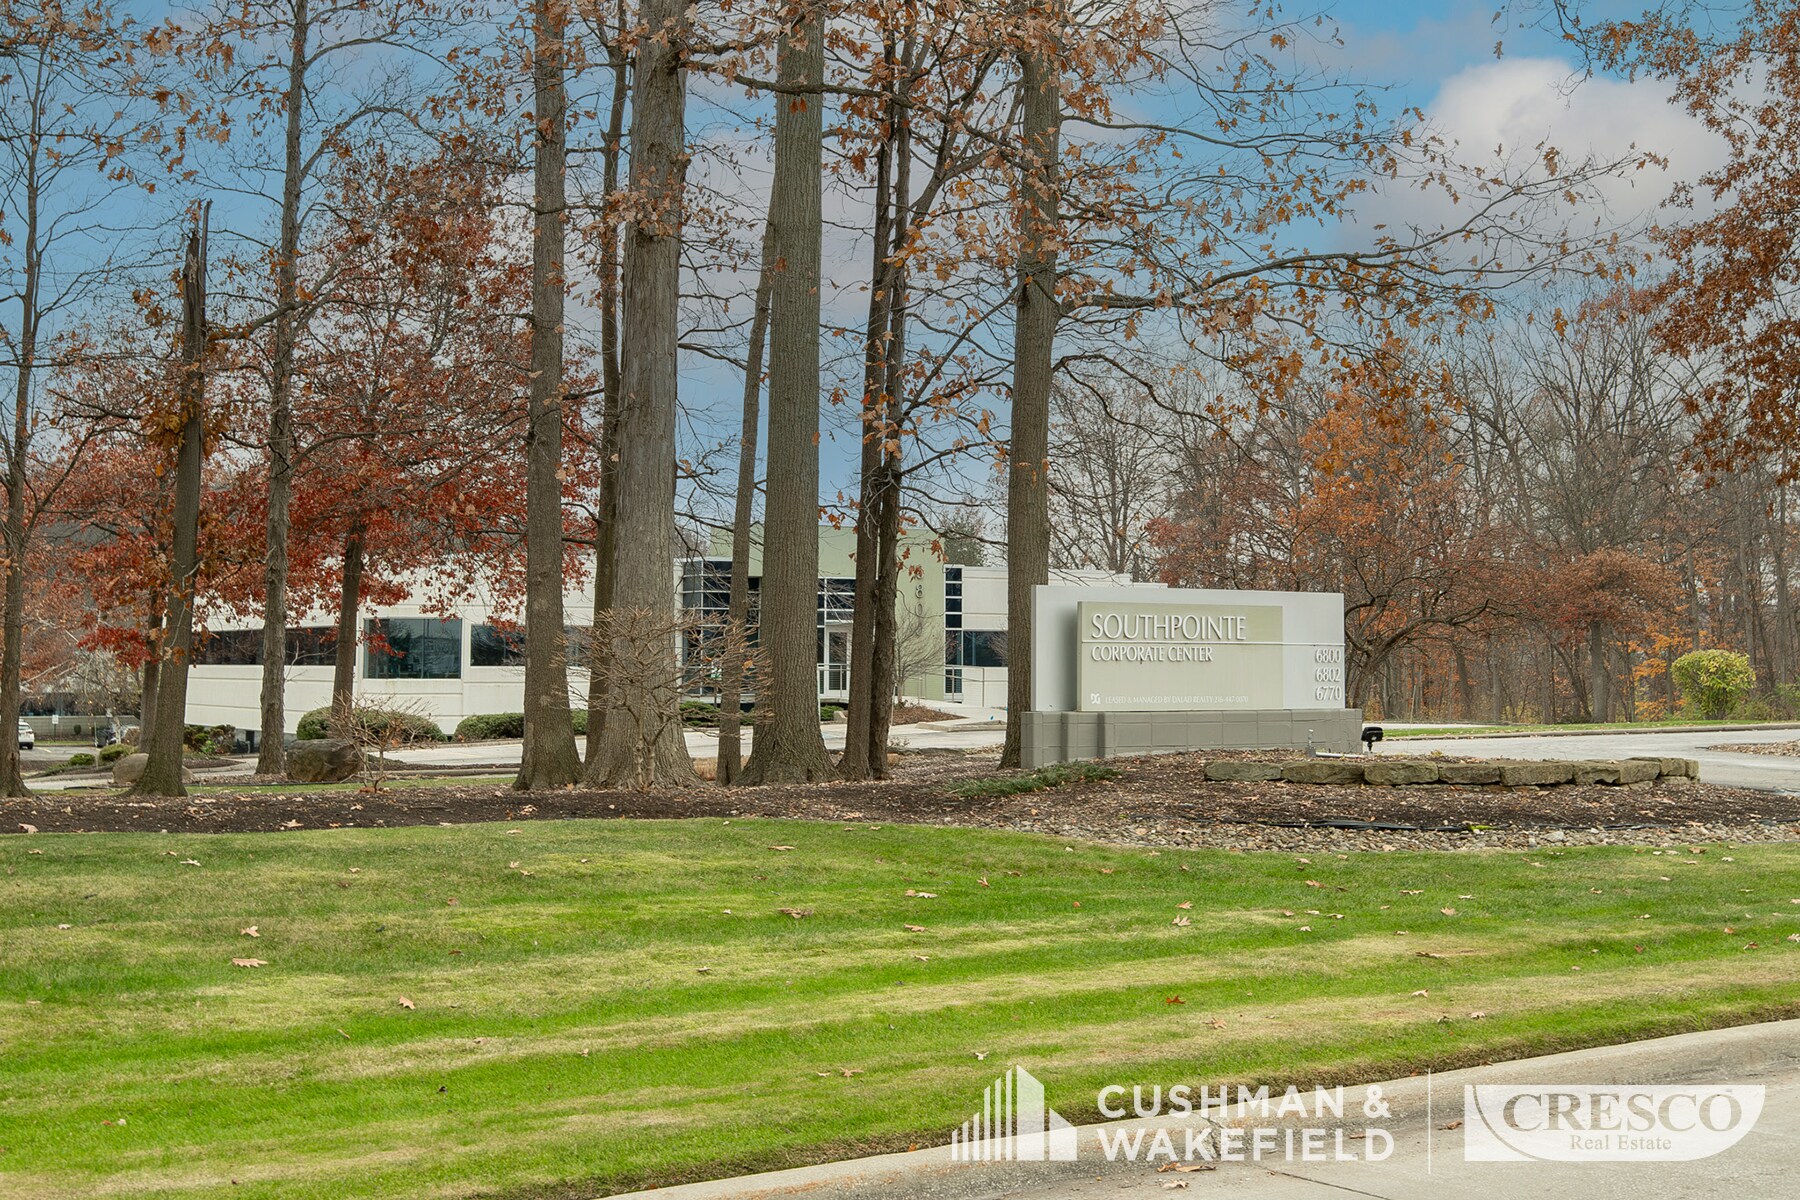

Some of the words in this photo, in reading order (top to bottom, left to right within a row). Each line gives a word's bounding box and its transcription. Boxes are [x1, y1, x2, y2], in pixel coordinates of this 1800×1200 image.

[1091, 613, 1247, 640] SOUTHPOINTE
[1091, 645, 1165, 661] CORPORATE
[1168, 646, 1213, 662] CENTER
[1315, 648, 1341, 663] 6800
[1315, 667, 1341, 682] 6802
[1315, 685, 1342, 701] 6770
